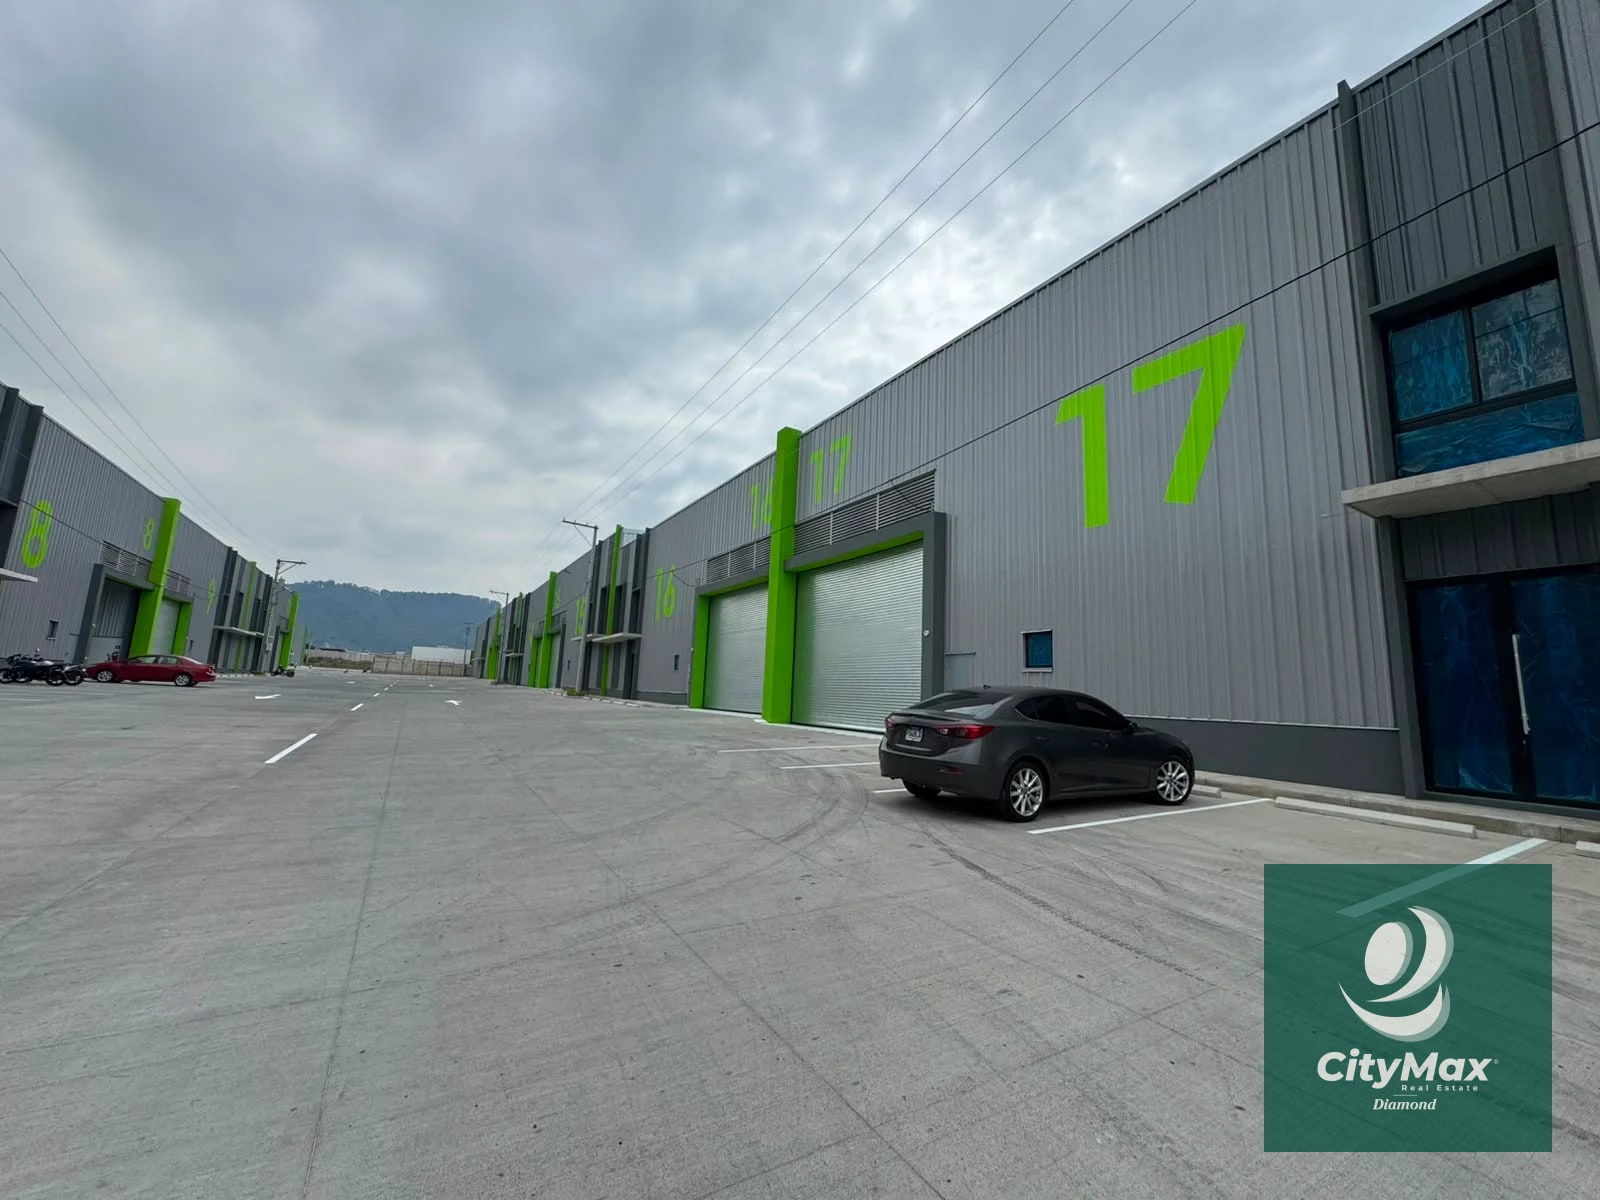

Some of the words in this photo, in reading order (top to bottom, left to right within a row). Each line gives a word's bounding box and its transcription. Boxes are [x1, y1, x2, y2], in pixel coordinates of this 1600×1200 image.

[1055, 321, 1246, 529] 17
[809, 432, 853, 505] 17
[21, 499, 53, 569] 8
[655, 563, 677, 623] 16
